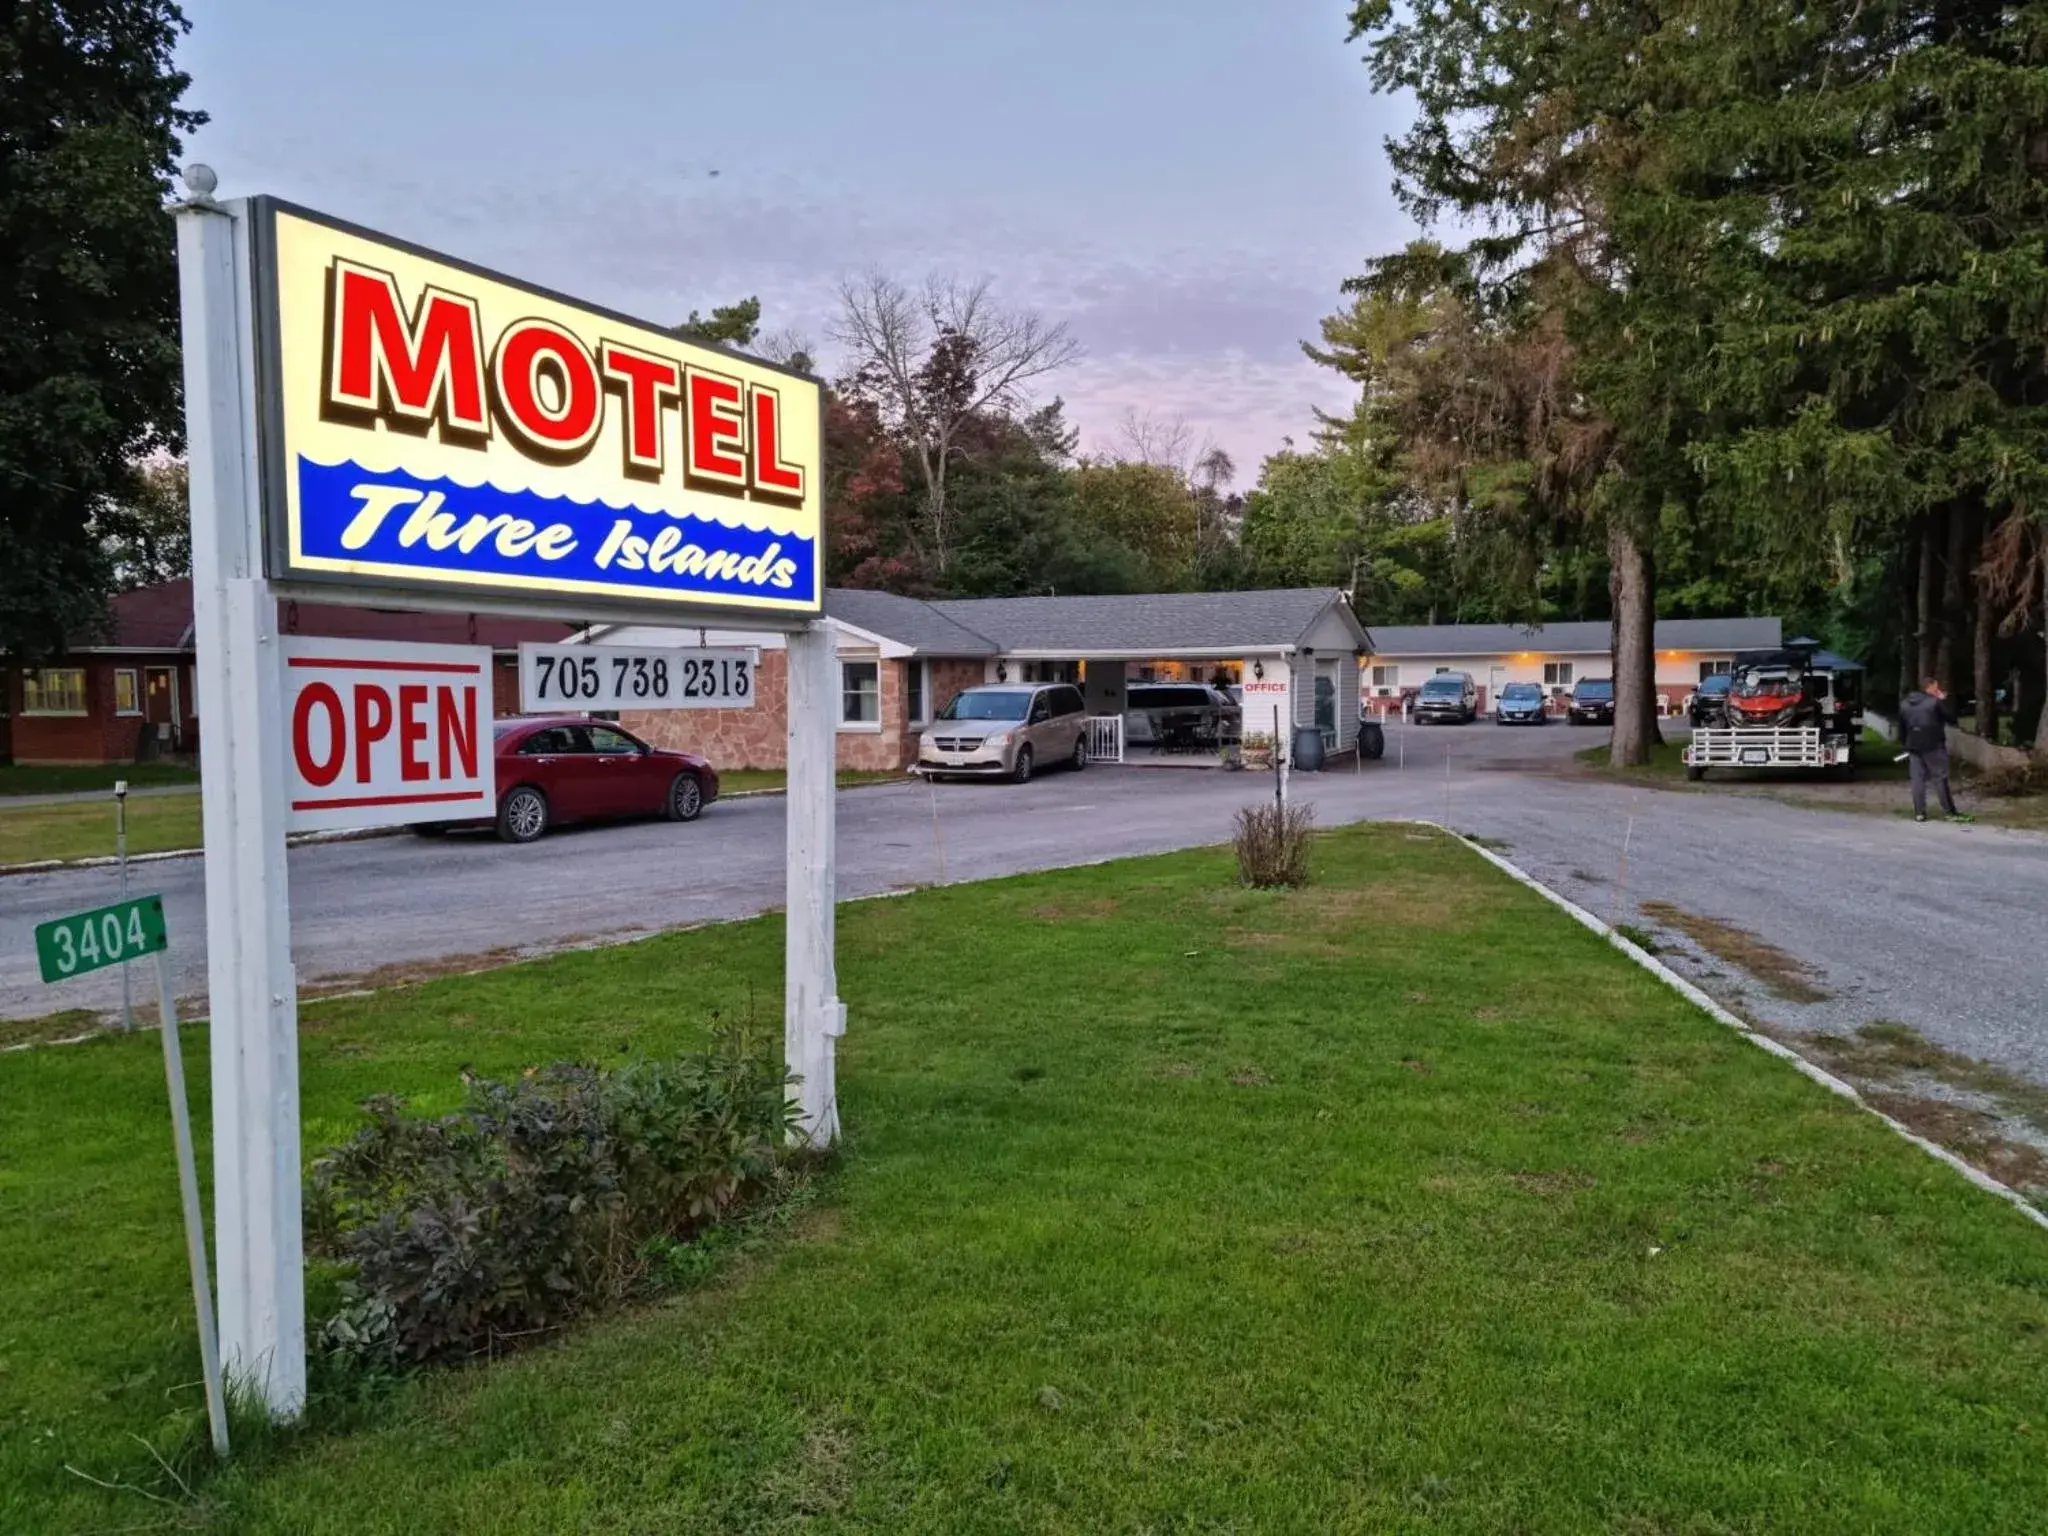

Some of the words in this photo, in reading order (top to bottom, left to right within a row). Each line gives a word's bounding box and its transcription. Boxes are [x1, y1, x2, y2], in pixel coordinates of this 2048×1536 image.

[320, 256, 805, 509] MOTEL
[339, 483, 578, 561] Three
[593, 519, 798, 590] Islands
[536, 656, 600, 698] 705
[612, 657, 669, 697] 738
[684, 659, 749, 697] 2313
[1244, 683, 1287, 692] OFFICE
[292, 681, 479, 787] OPEN
[53, 906, 146, 973] 3404
